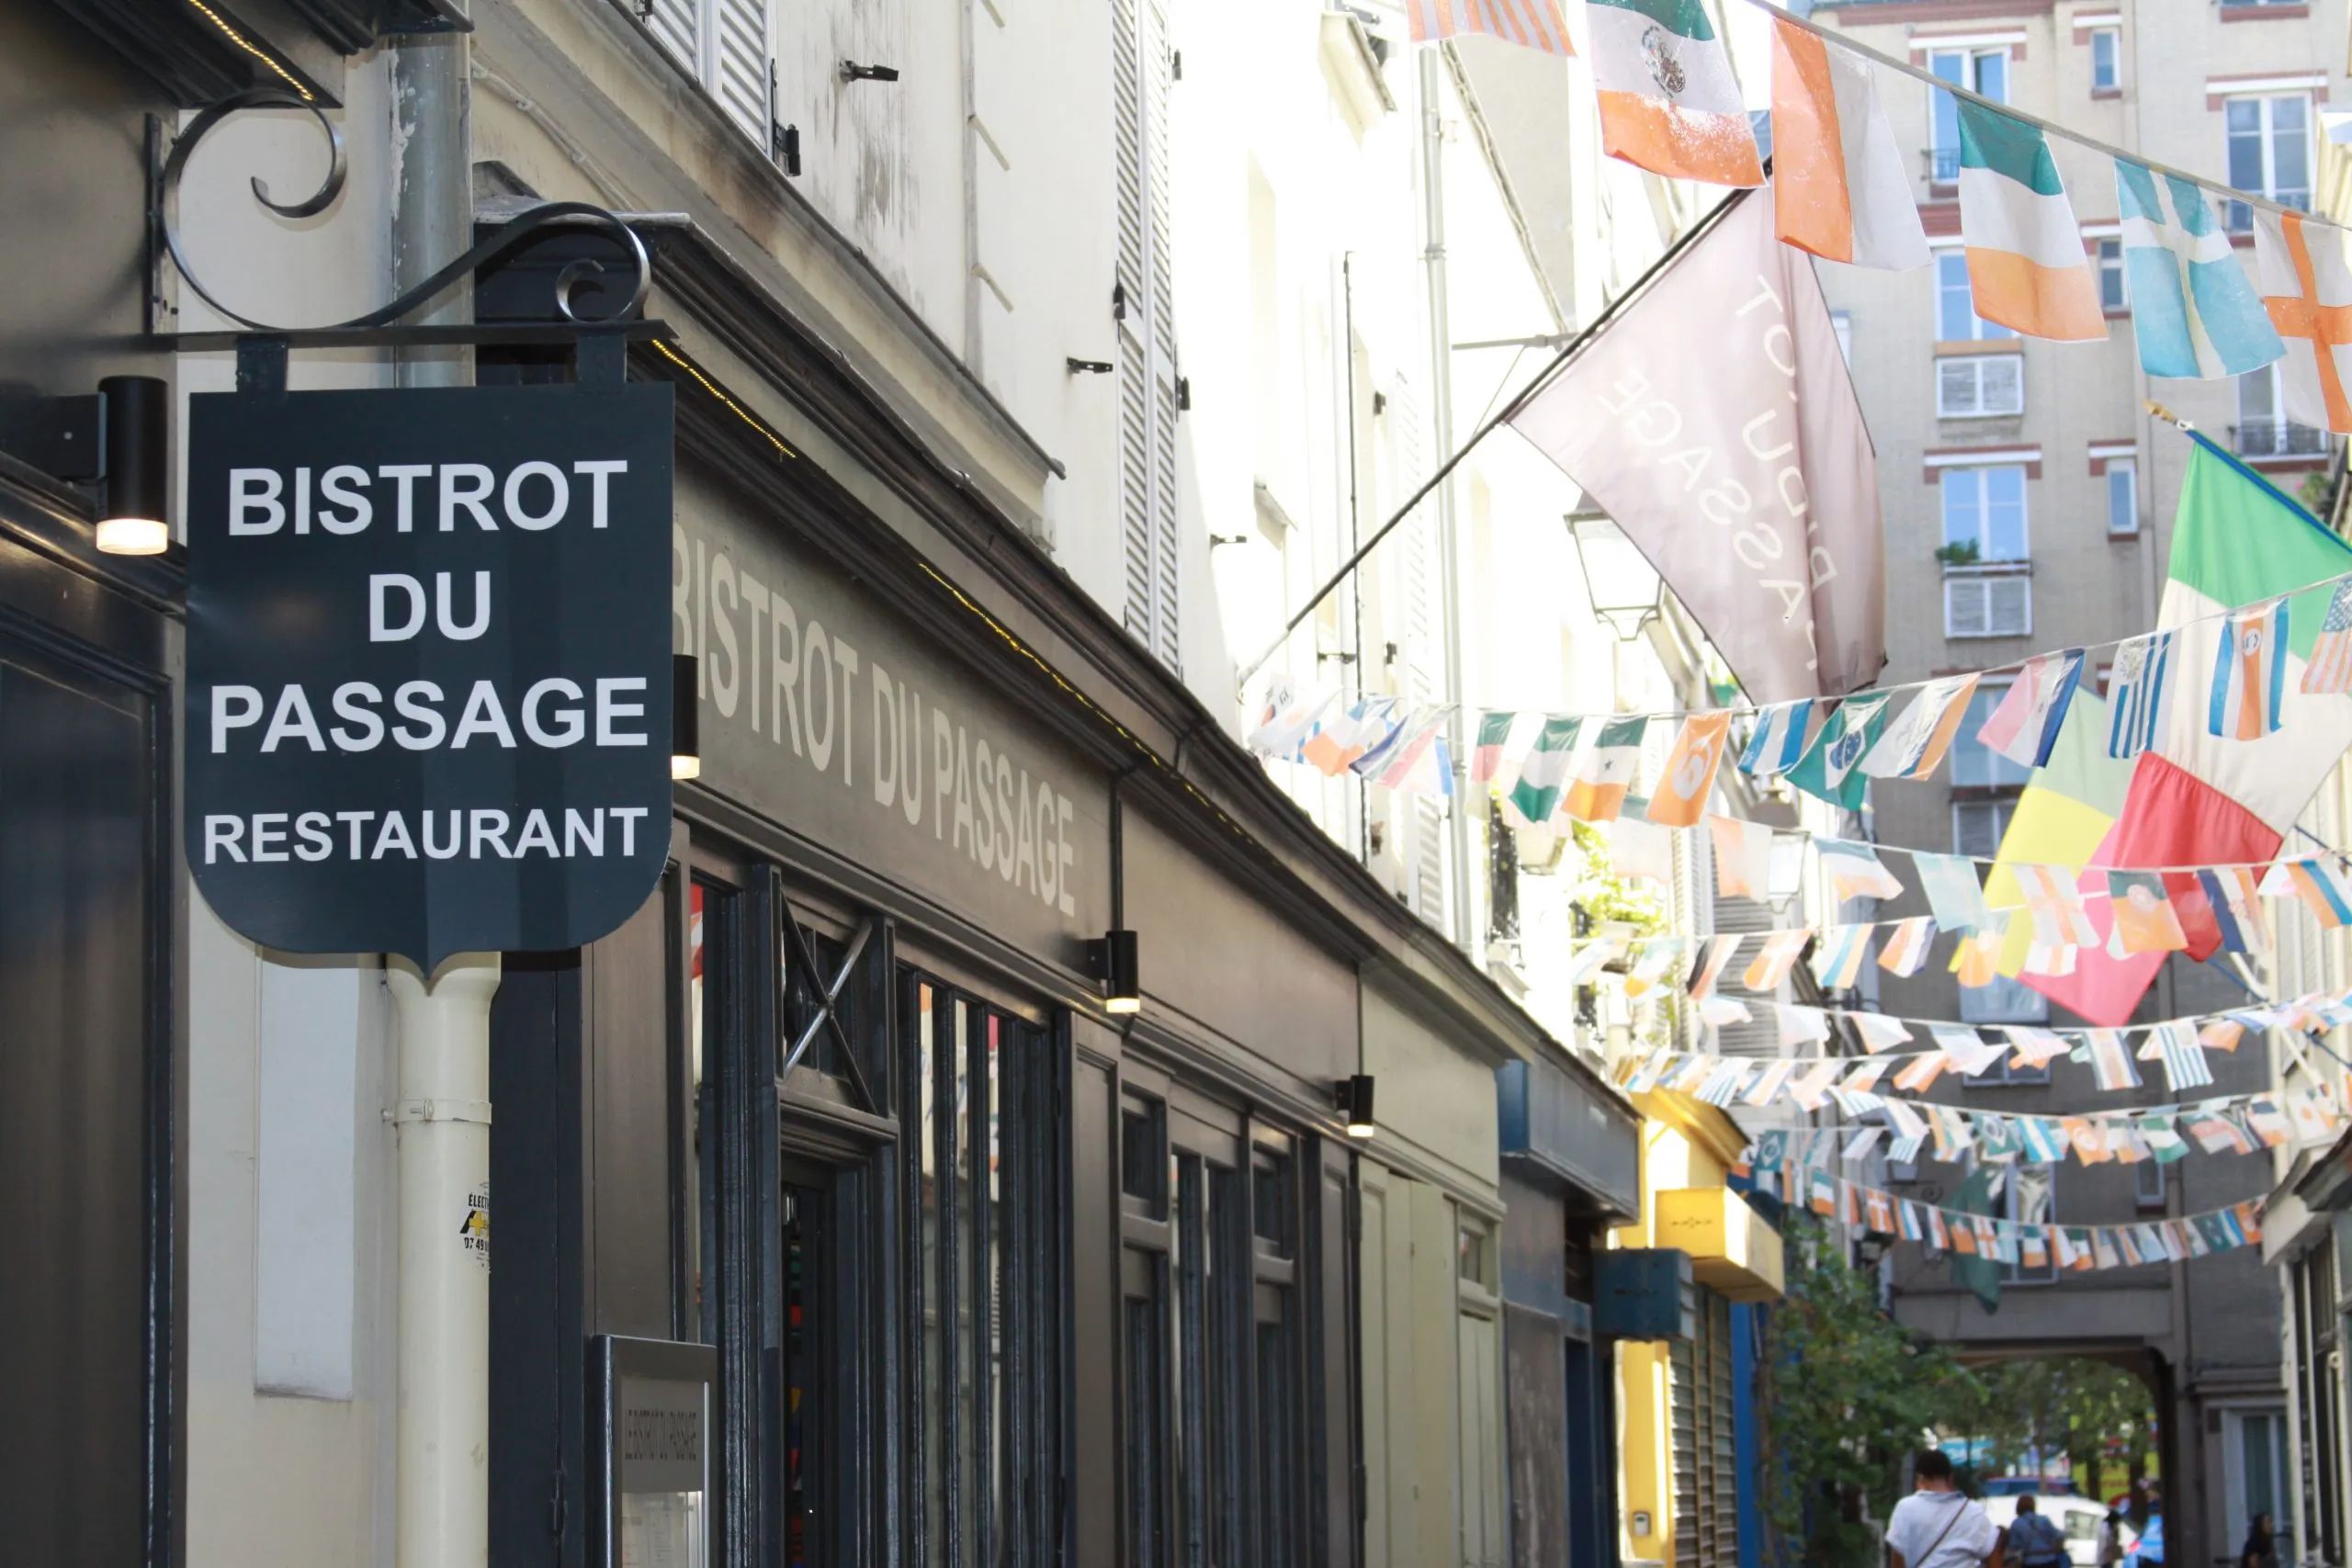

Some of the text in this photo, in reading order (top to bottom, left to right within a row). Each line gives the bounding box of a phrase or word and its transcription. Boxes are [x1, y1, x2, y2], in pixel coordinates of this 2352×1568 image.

[228, 459, 628, 536] BISTROT
[368, 570, 492, 643] DU
[210, 676, 649, 754] PASSAGE
[872, 661, 922, 827] DU
[933, 707, 1075, 919] PASSAGE
[204, 807, 649, 865] RESTAURANT
